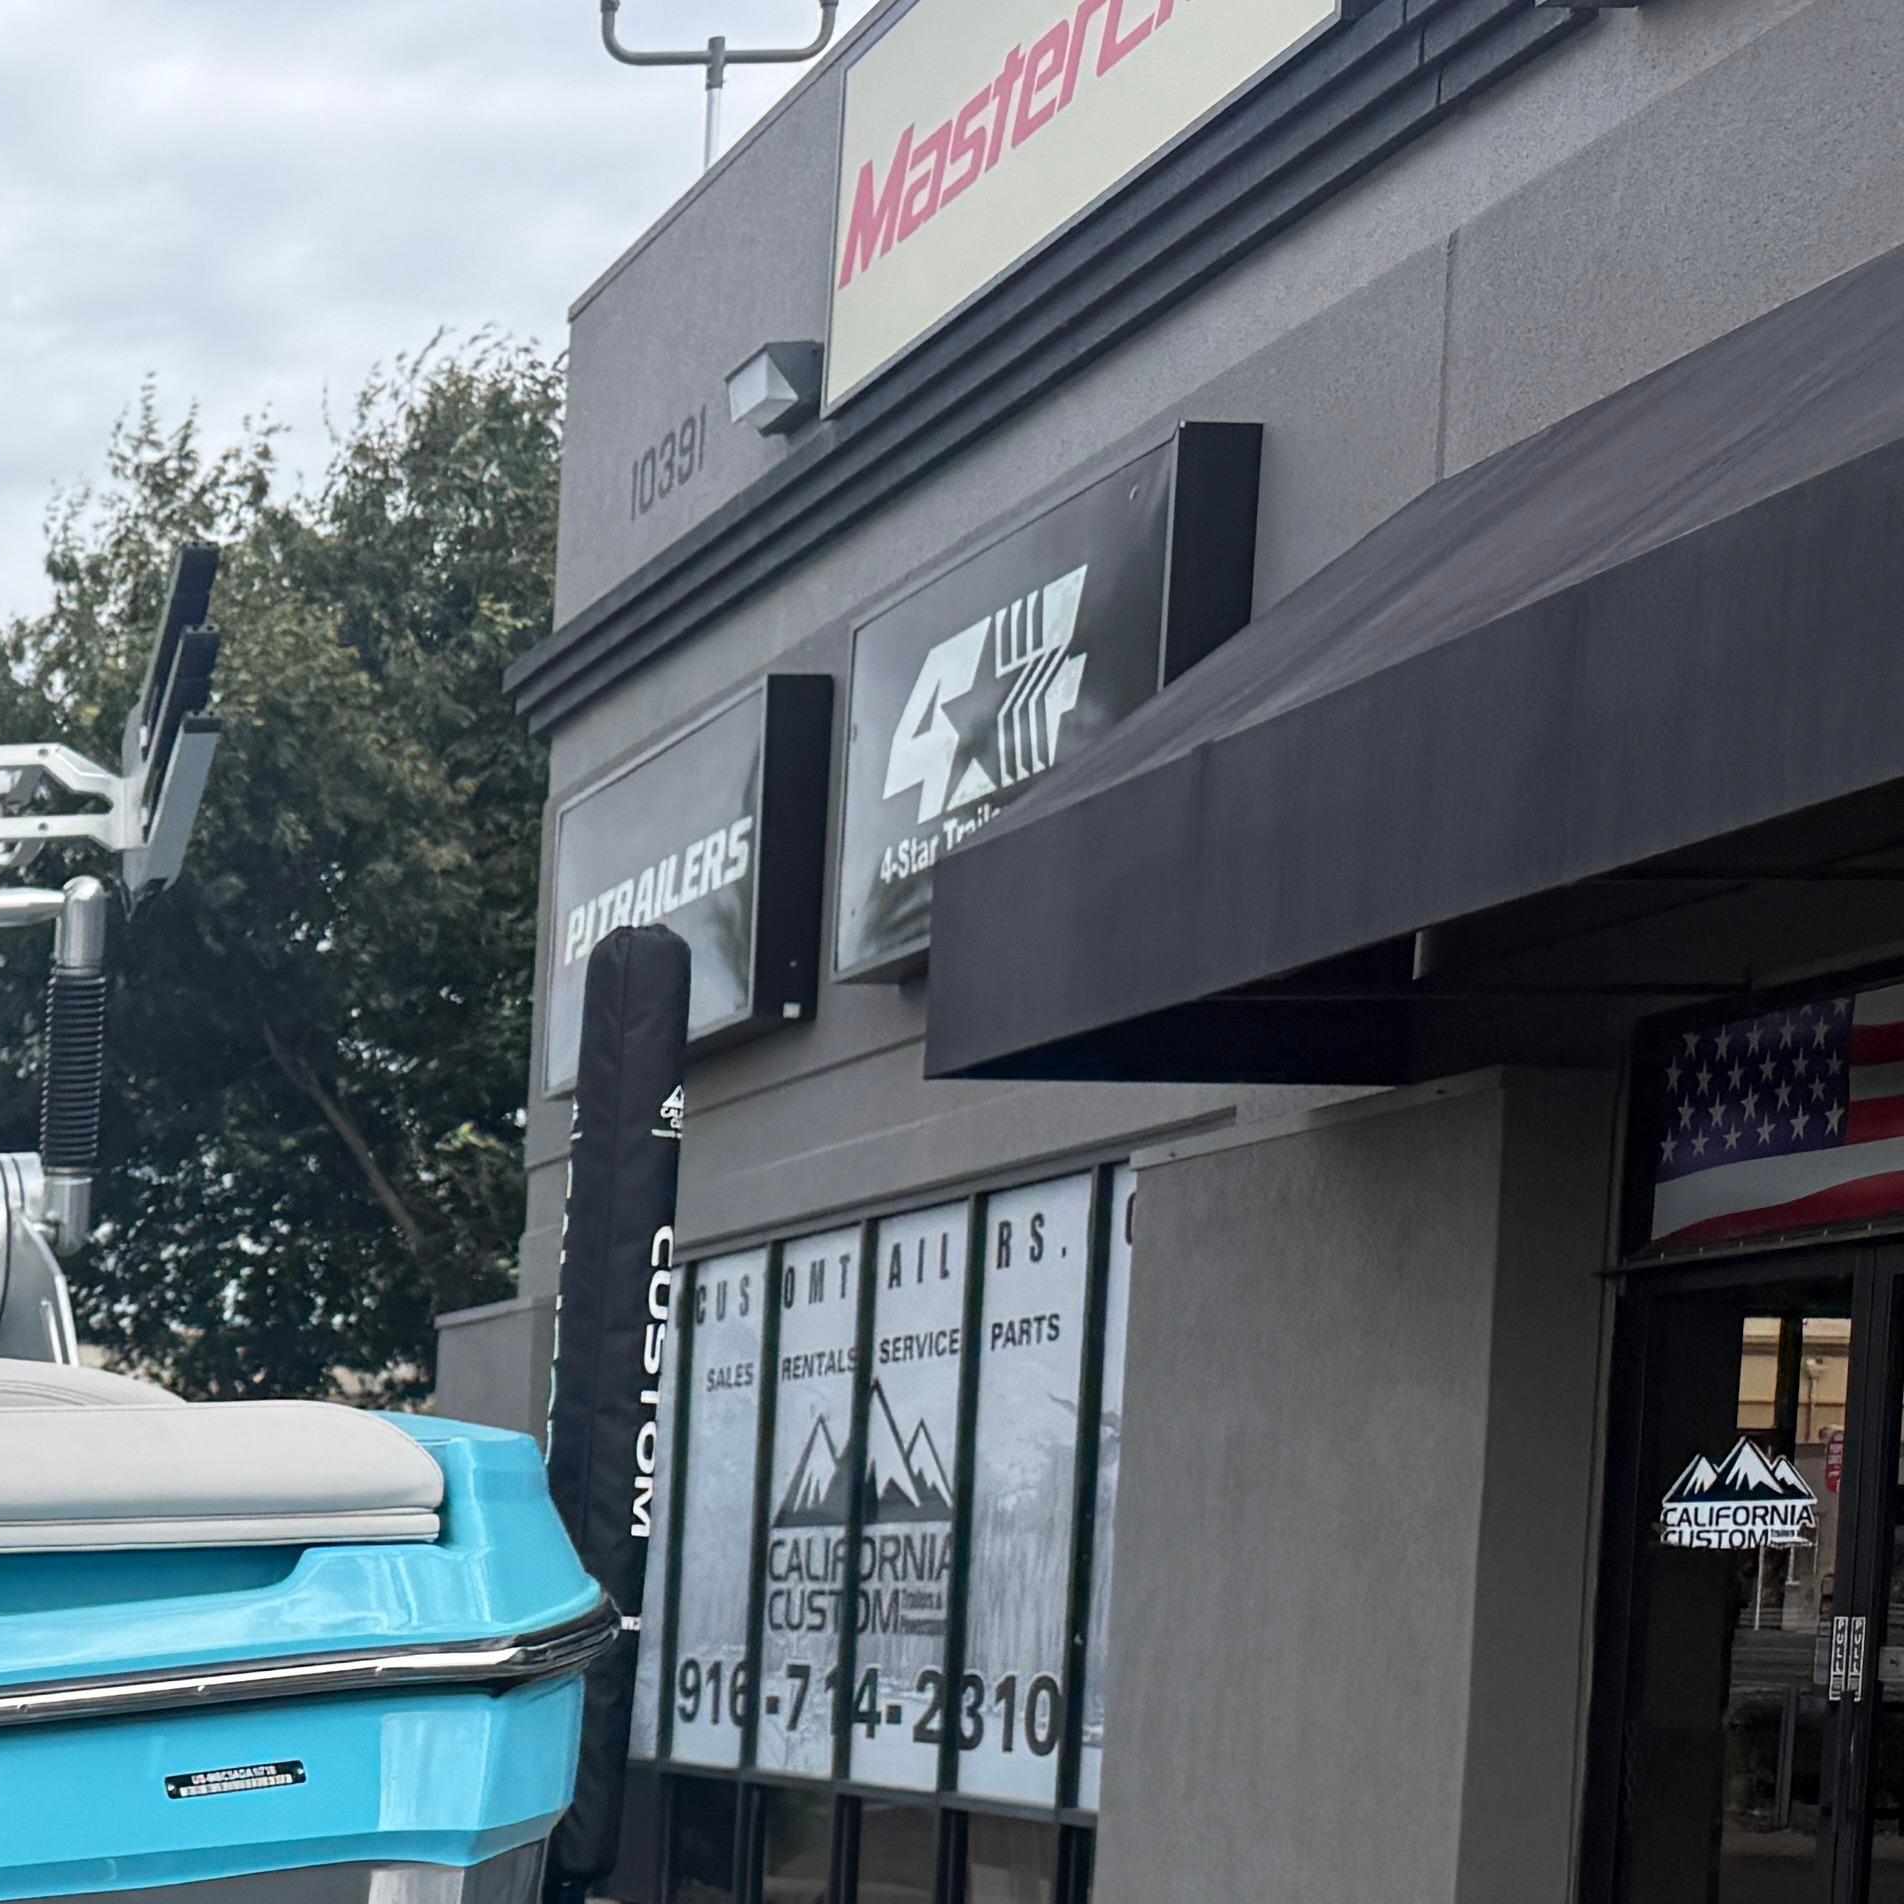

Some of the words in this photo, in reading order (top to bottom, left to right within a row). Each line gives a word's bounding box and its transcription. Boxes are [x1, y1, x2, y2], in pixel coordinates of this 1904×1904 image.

[632, 403, 706, 521] 10391
[880, 834, 940, 884] 4-Star
[706, 1362, 754, 1393] SALES
[781, 1344, 860, 1381] RENTALS
[879, 1328, 960, 1364] SERVICE
[991, 1313, 1060, 1351] PARTS
[1663, 1504, 1813, 1527] CALIFORNIA
[1663, 1528, 1769, 1549] CUSTOM
[1835, 1620, 1844, 1673] PULL
[1853, 1620, 1862, 1673] PULL
